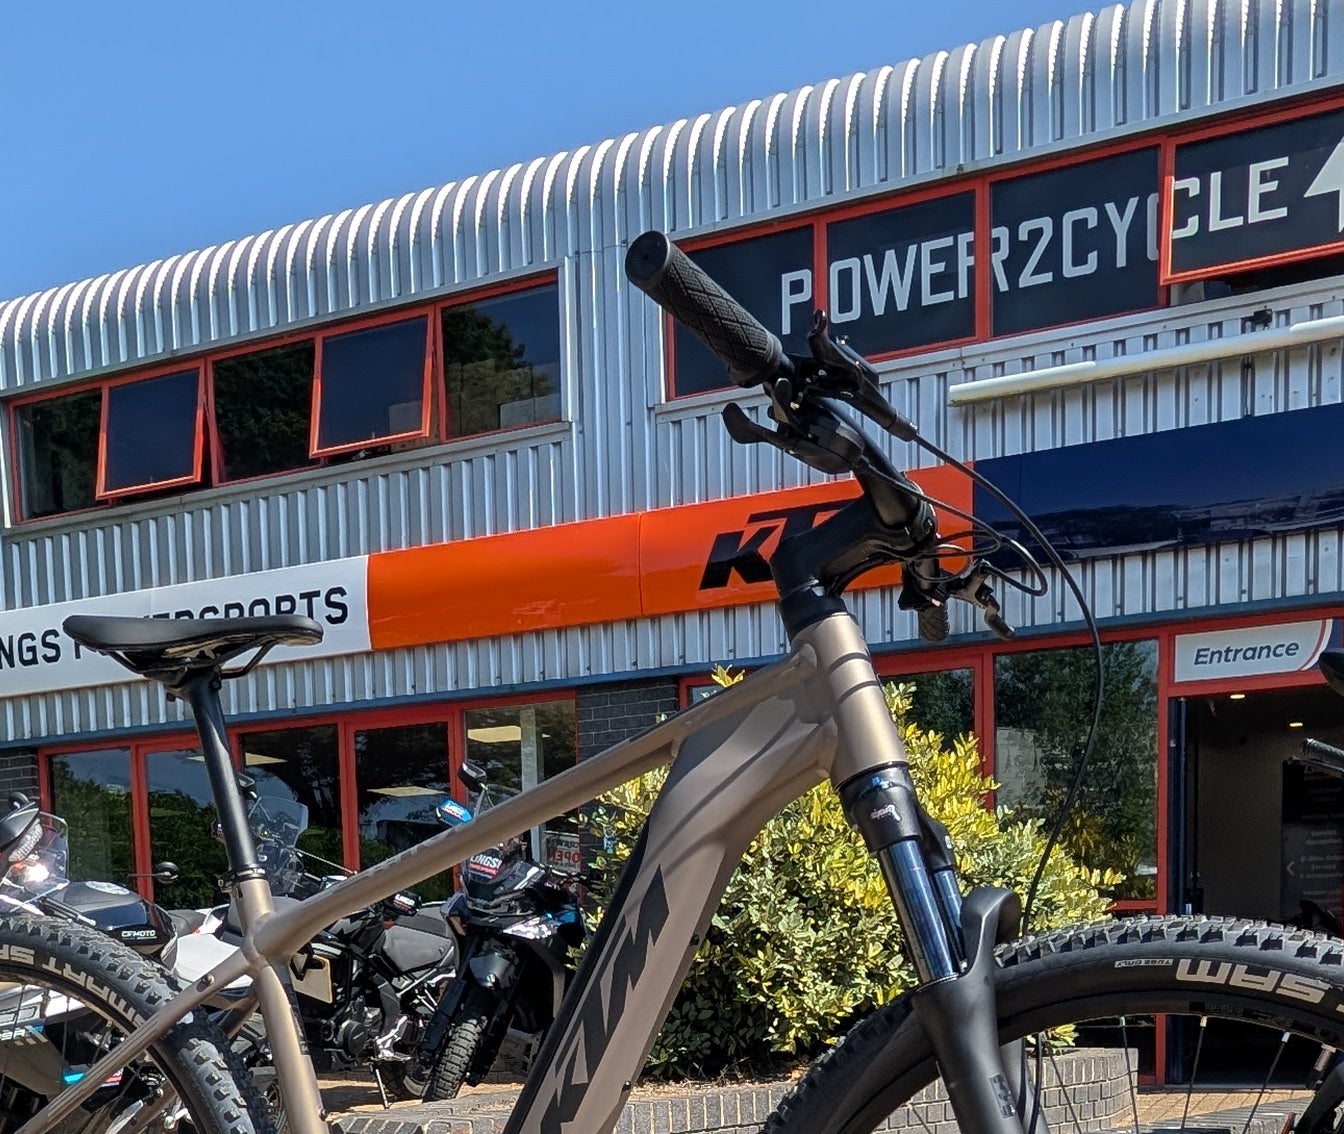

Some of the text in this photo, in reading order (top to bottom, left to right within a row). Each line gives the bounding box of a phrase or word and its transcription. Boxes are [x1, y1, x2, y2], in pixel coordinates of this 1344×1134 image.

[699, 499, 861, 590] KT
[1194, 641, 1300, 666] Entrance
[1175, 957, 1332, 1004] SAM
